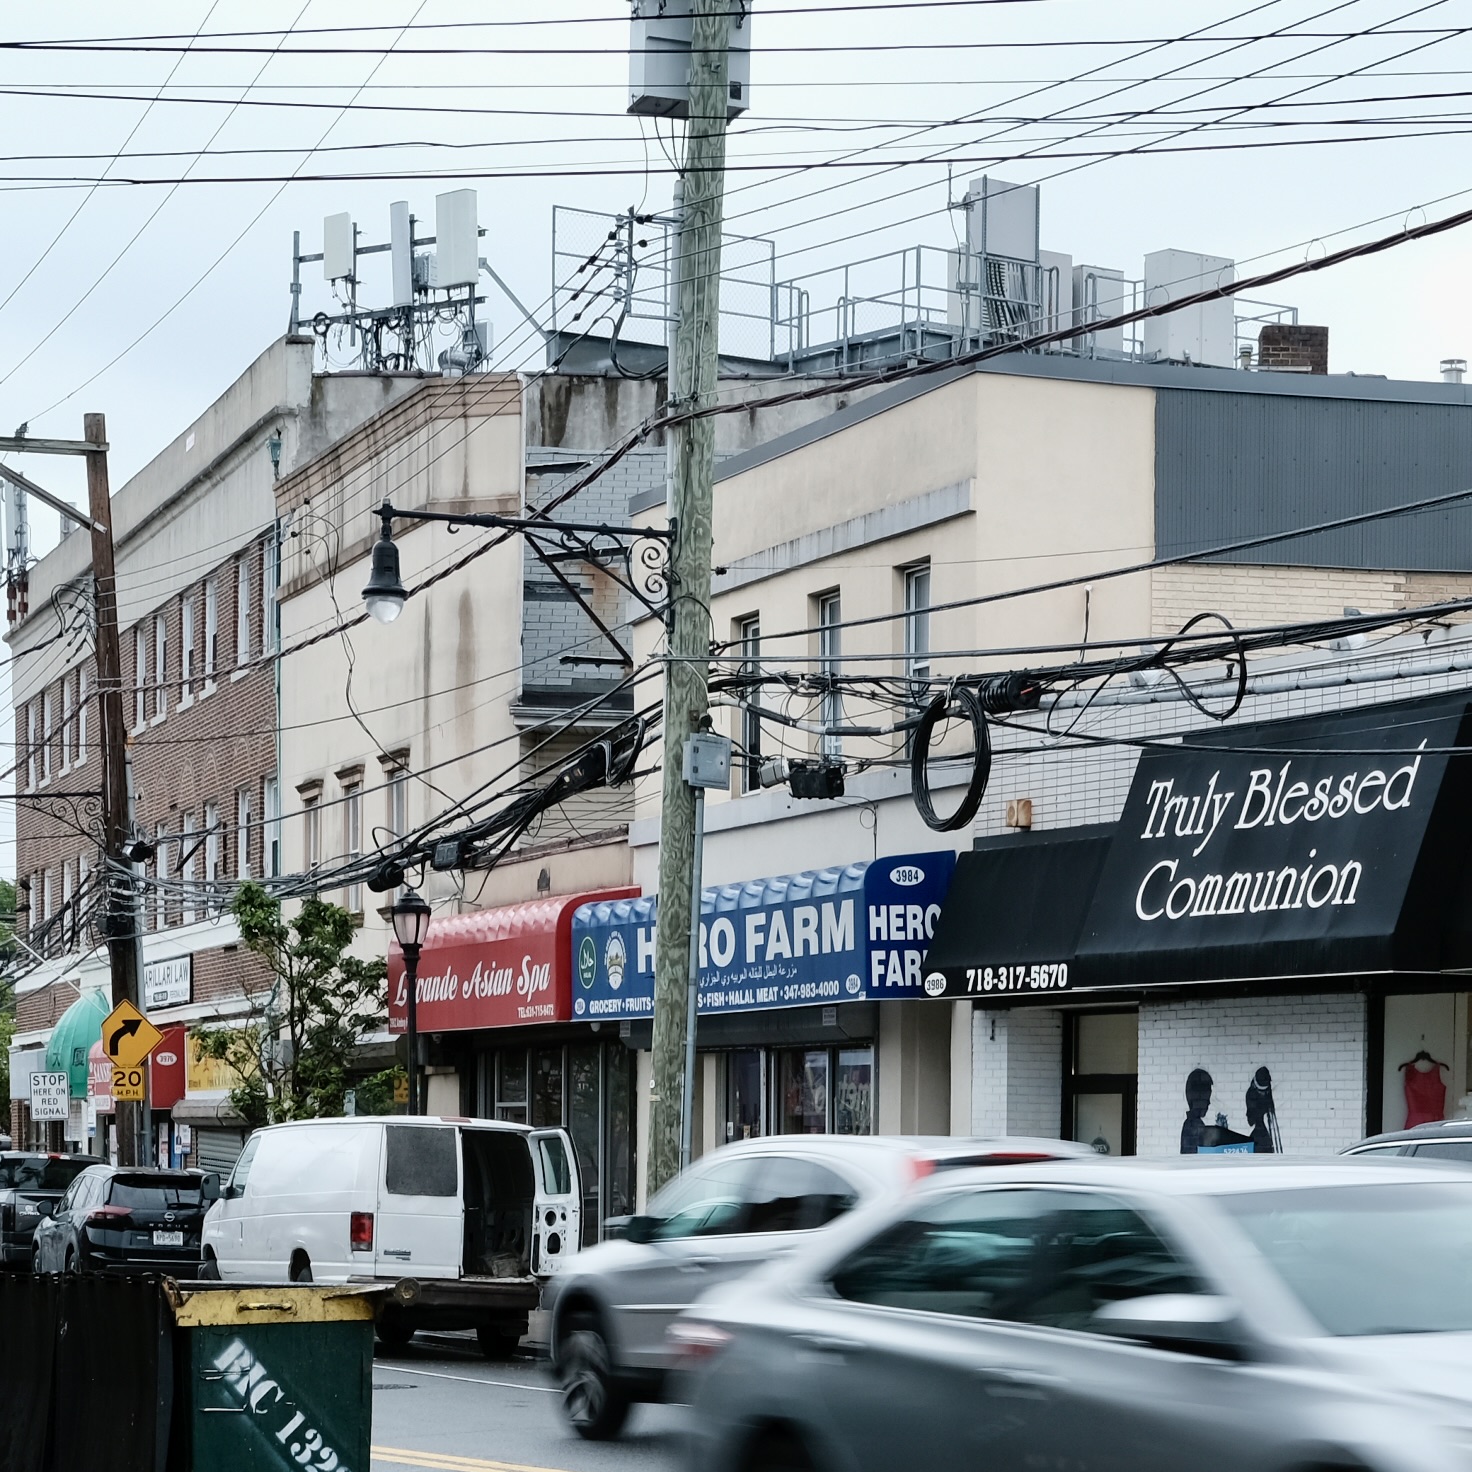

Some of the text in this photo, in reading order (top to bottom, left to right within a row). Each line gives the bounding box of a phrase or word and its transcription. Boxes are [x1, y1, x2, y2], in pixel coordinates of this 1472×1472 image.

[1140, 738, 1428, 857] Truly Blessed
[895, 869, 919, 882] 3984
[1135, 848, 1362, 921] Communion
[745, 898, 855, 964] FARM
[174, 963, 189, 983] LAW
[871, 950, 928, 987] FAR
[966, 963, 1068, 992] 718-317-5670
[393, 955, 551, 1007] Lvande Asian Spa
[783, 980, 840, 1000] 347-983-4000
[926, 978, 944, 990] 3986
[590, 998, 623, 1014] GROCERY
[625, 996, 651, 1012] FRUITS
[707, 991, 725, 1007] FISH
[728, 988, 755, 1006] HALAL
[756, 986, 779, 1003] MEAT
[32, 1074, 66, 1087] STOP
[113, 1070, 141, 1087] 20
[33, 1086, 66, 1095] HERE ON
[34, 1107, 66, 1116] SIGNAL
[41, 1098, 59, 1106] RED
